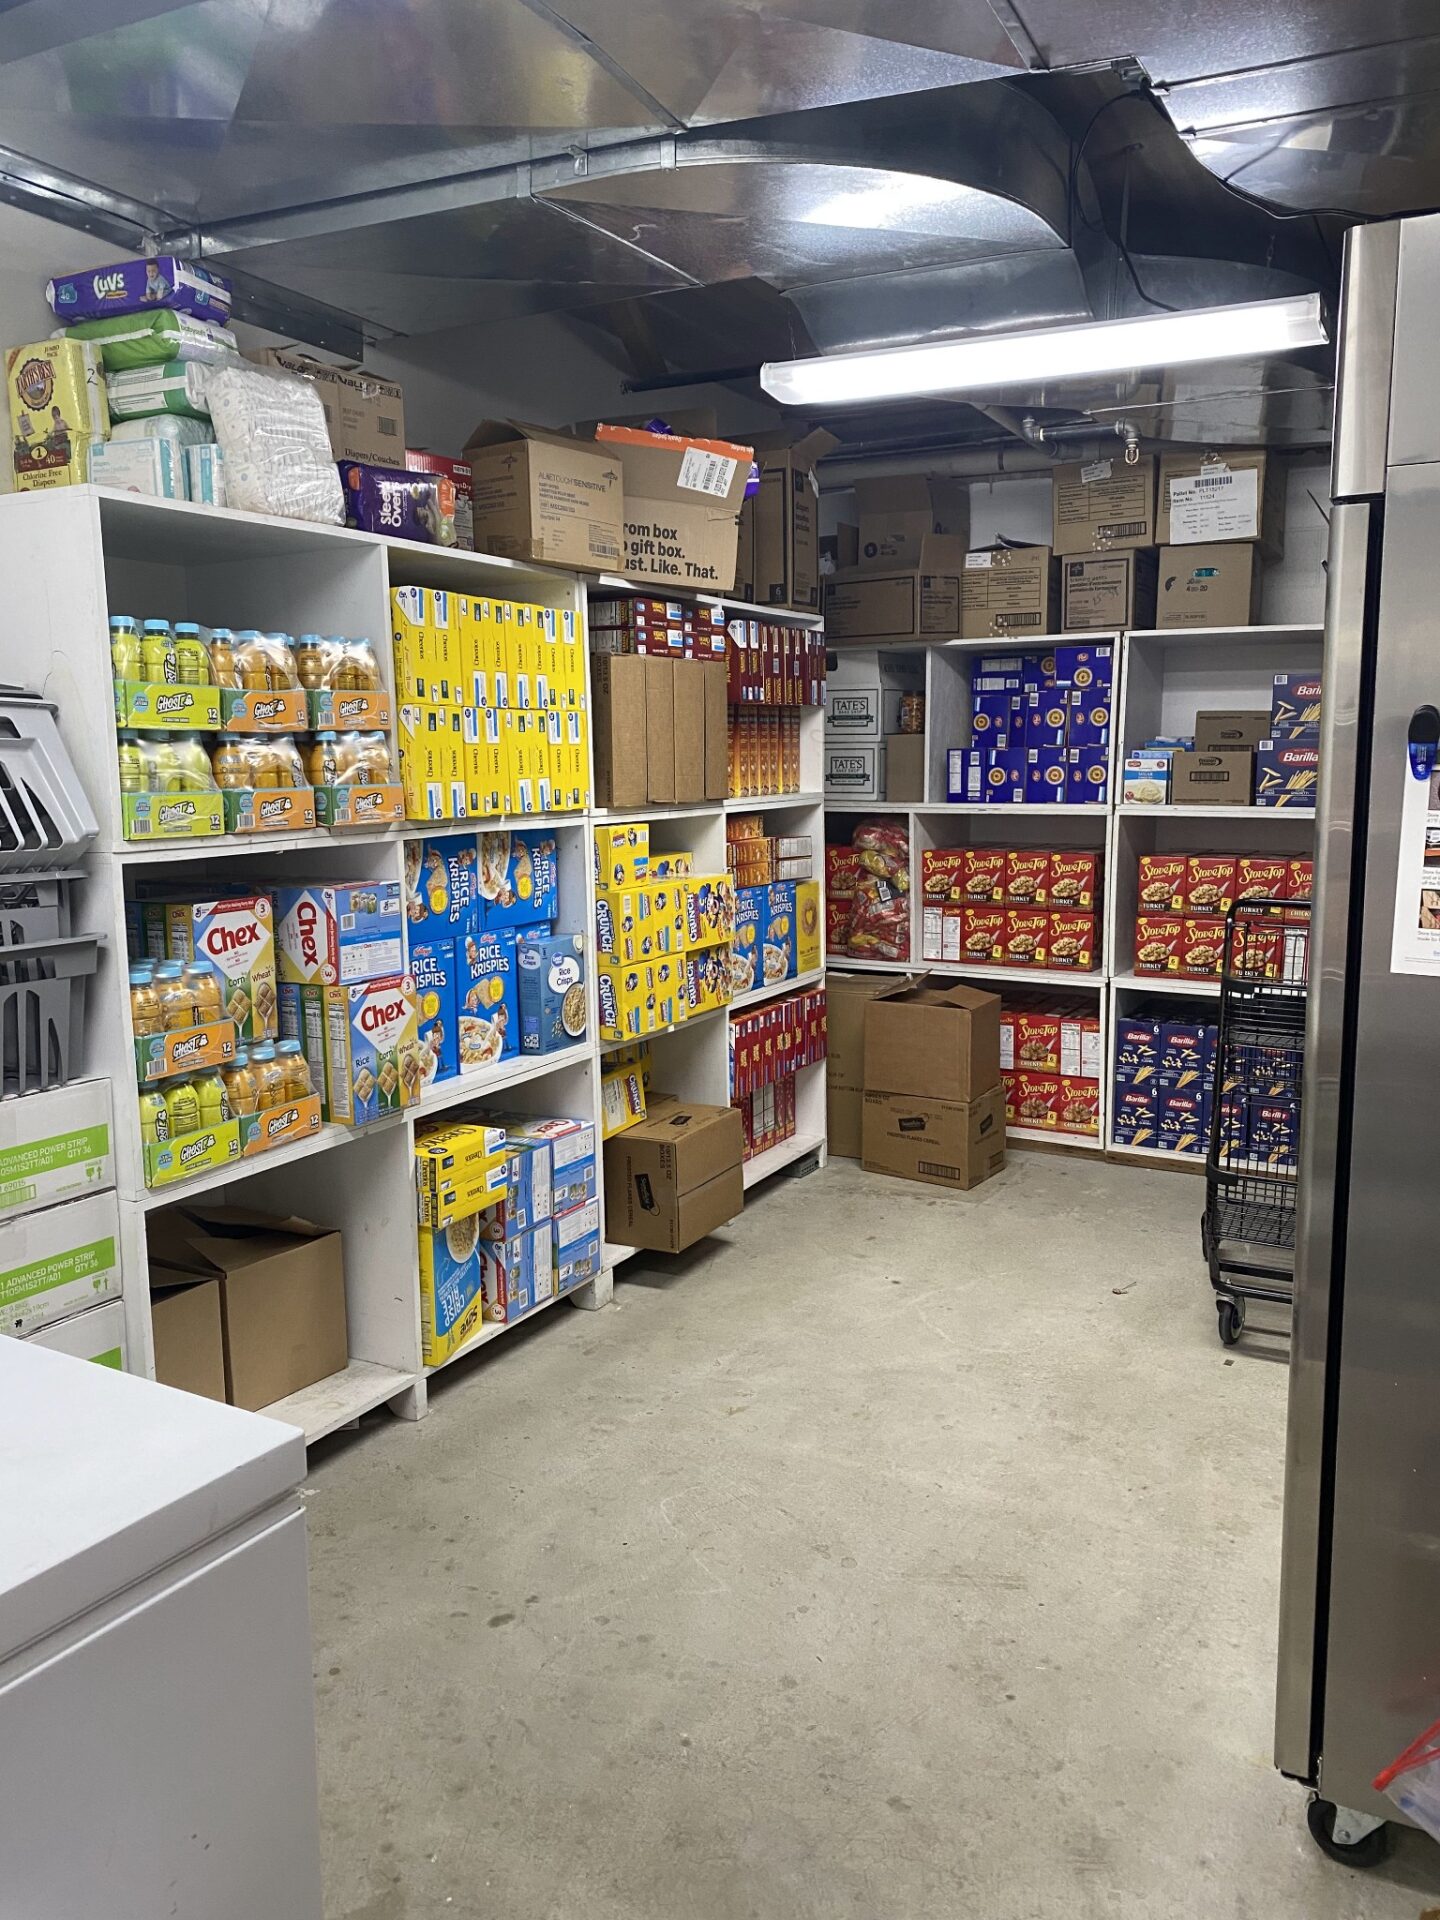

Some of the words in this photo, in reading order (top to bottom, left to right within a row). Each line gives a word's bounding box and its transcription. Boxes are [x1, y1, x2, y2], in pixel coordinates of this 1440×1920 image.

[87, 368, 98, 385] 2
[345, 448, 400, 466] Diapers/Couches
[23, 471, 47, 481] Chlorine
[49, 470, 62, 479] Free
[33, 479, 56, 488] Diapers
[624, 523, 650, 537] rom
[653, 524, 678, 540] box
[631, 539, 655, 556] gift
[658, 541, 686, 559] box.
[625, 558, 647, 572] ust.
[651, 558, 682, 576] Like.
[685, 562, 718, 580] That.
[157, 694, 187, 713] GHOST
[835, 700, 866, 711] TATE'S
[208, 708, 217, 718] 12
[298, 711, 304, 720] 12
[380, 712, 388, 720] 12
[1283, 752, 1318, 761] Barilla
[833, 759, 863, 769] TATE'S
[210, 815, 219, 824] 12
[304, 810, 312, 819] 12
[532, 848, 542, 908] KRISPIES
[542, 860, 550, 895] RICE
[448, 857, 460, 923] KRISPIES
[460, 870, 469, 908] RICE
[776, 893, 788, 902] RICE
[1009, 895, 1030, 903] TURKEY
[1052, 897, 1073, 905] TURKEY
[261, 904, 265, 913] 3
[741, 899, 754, 909] RICE
[770, 903, 793, 916] KRISPIES
[686, 893, 698, 942] CRUNCH
[736, 910, 759, 925] KRISPIES
[596, 899, 613, 954] CRUNCH
[207, 922, 261, 955] Chex
[297, 901, 318, 967] Chex
[479, 945, 500, 961] RICE
[411, 958, 437, 974] RICE
[1052, 956, 1073, 964] TURKEY
[471, 958, 510, 979] KRISPIES
[228, 975, 246, 987] Corn
[252, 970, 272, 983] Wheat
[416, 972, 447, 988] ISPIES
[556, 977, 573, 986] Crisps
[406, 982, 410, 990] 3
[686, 961, 698, 1008] CRUNCH
[599, 975, 616, 1028] CRUNCH
[361, 999, 406, 1031] Chex
[1153, 1025, 1160, 1033] 6
[1198, 1029, 1204, 1037] 6
[1127, 1033, 1150, 1041] Barilla
[1170, 1037, 1195, 1045] Barilla
[173, 1035, 201, 1062] GHOST
[222, 1042, 232, 1052] 12
[399, 1042, 415, 1054] Wheat
[380, 1049, 394, 1061] Corn
[356, 1056, 370, 1068] Rice
[628, 1074, 640, 1114] CRUNCH
[1152, 1088, 1157, 1096] 6
[1196, 1093, 1202, 1101] 6
[1125, 1095, 1148, 1103] Barilla
[1168, 1099, 1193, 1108] Barilla
[268, 1111, 294, 1137] GHOST
[310, 1116, 319, 1125] 12
[1021, 1117, 1043, 1125] CHICKEN
[40, 1143, 66, 1157] POWER
[67, 1136, 88, 1149] STRIP
[67, 1147, 82, 1158] QTY
[83, 1145, 92, 1153] 36
[181, 1136, 209, 1165] GHOST
[229, 1141, 238, 1150] 12
[7, 1268, 46, 1288] ADVANCED
[47, 1258, 74, 1273] POWER
[75, 1251, 96, 1264] STRIP
[75, 1262, 89, 1273] QTY
[90, 1259, 98, 1268] 36
[441, 1285, 459, 1314] RICE
[444, 1294, 465, 1328] CRISP
